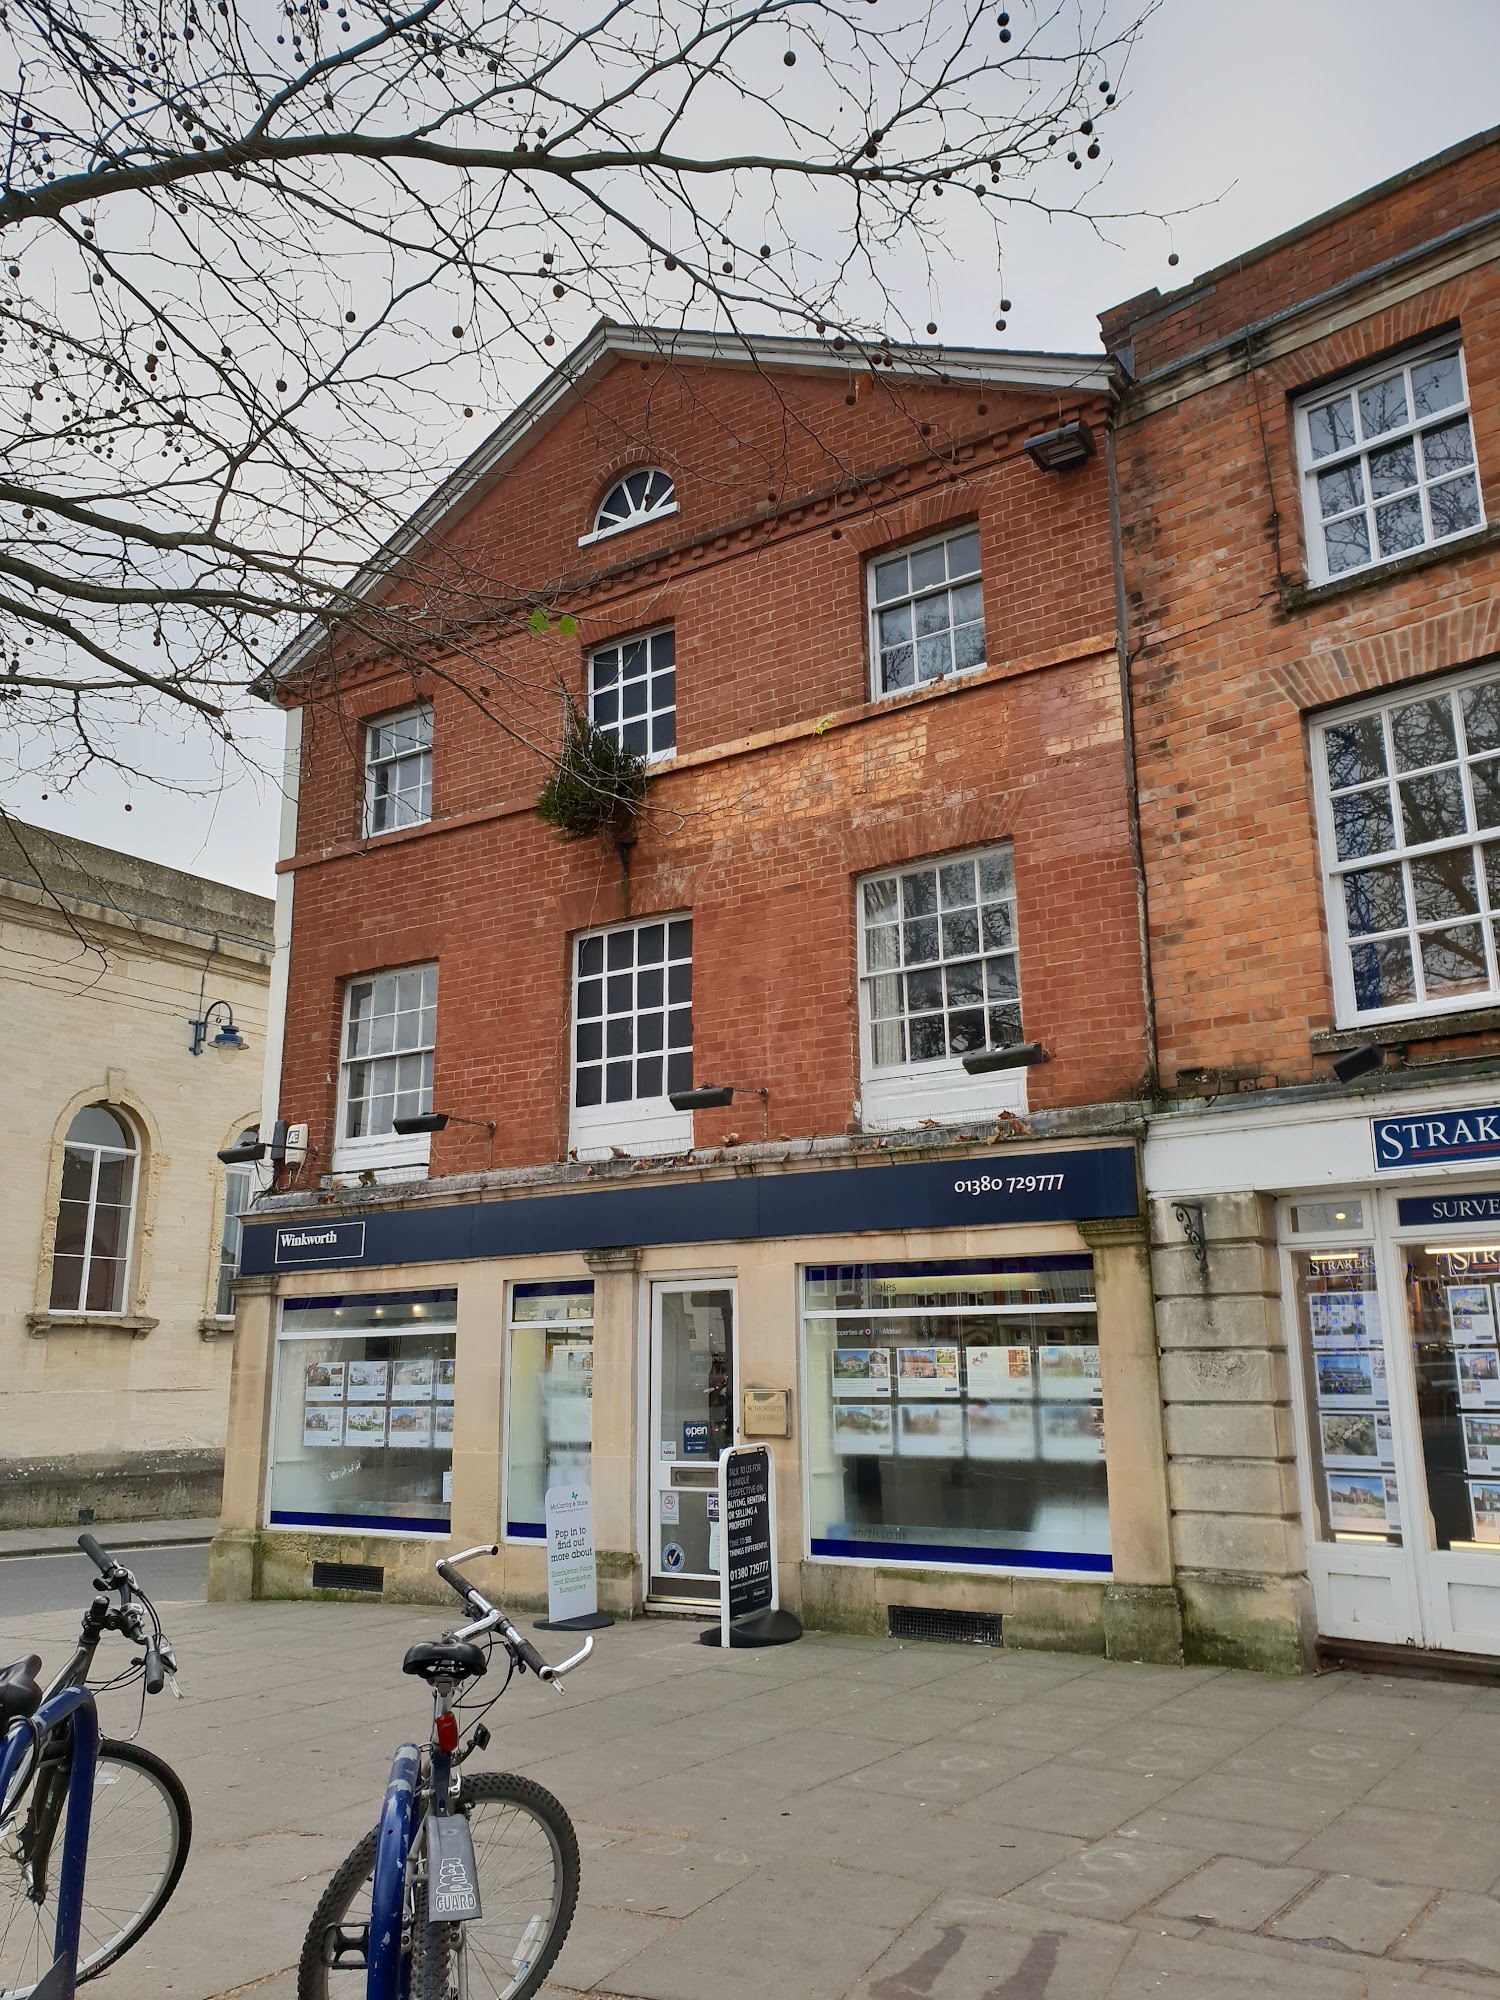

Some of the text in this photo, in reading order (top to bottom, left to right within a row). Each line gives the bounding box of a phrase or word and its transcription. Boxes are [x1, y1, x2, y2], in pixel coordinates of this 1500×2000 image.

[954, 1173, 1064, 1195] 01380 729777
[281, 1230, 337, 1247] Winkworth
[685, 1426, 708, 1437] open
[555, 1526, 586, 1539] Pop in to
[557, 1538, 585, 1550] find out
[551, 1548, 592, 1562] more about
[730, 1560, 769, 1581] 01380 729777
[436, 1893, 476, 1912] GUARD
